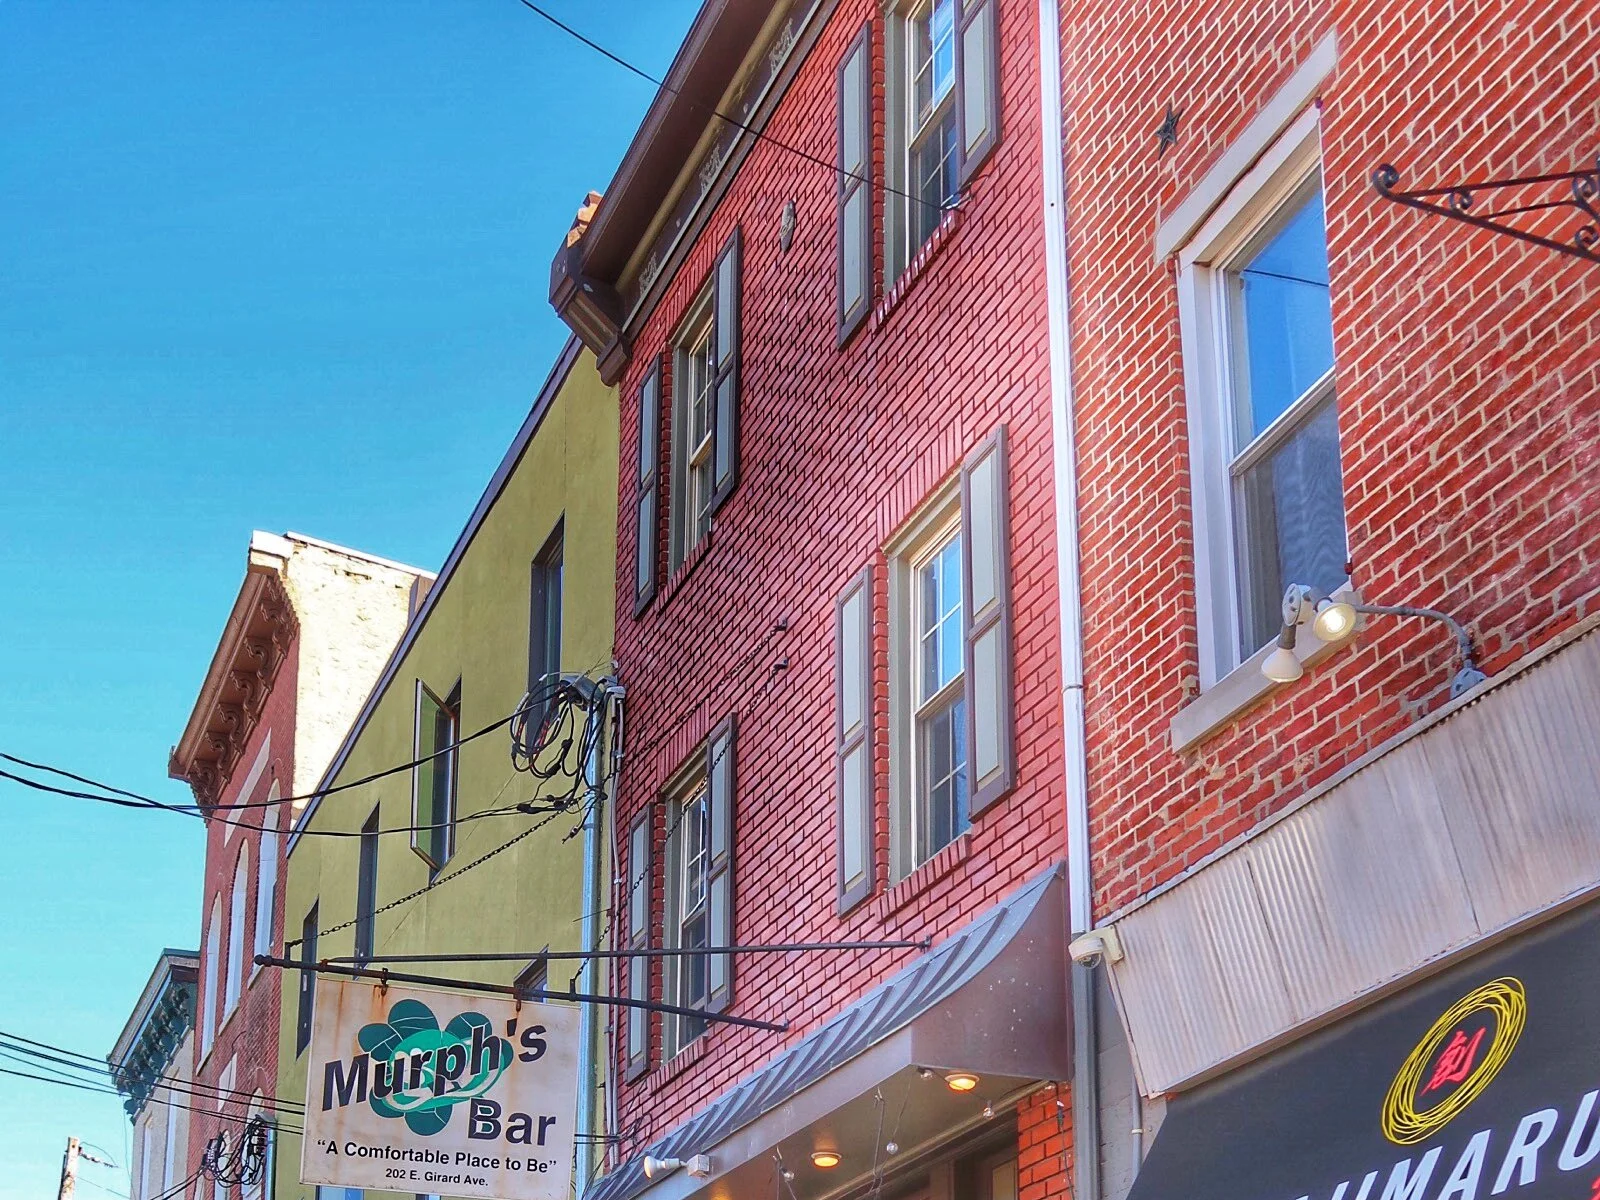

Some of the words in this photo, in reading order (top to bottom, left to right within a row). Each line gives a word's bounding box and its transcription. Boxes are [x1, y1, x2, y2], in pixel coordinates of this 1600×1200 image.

[322, 1017, 547, 1112] Murph's
[467, 1097, 556, 1146] Bar
[344, 1141, 450, 1165] Comfortable
[455, 1151, 500, 1169] Place
[505, 1157, 521, 1170] to
[385, 1168, 406, 1180] 202
[409, 1169, 421, 1181] E.
[424, 1171, 461, 1184] Girard
[463, 1174, 489, 1187] Ave.
